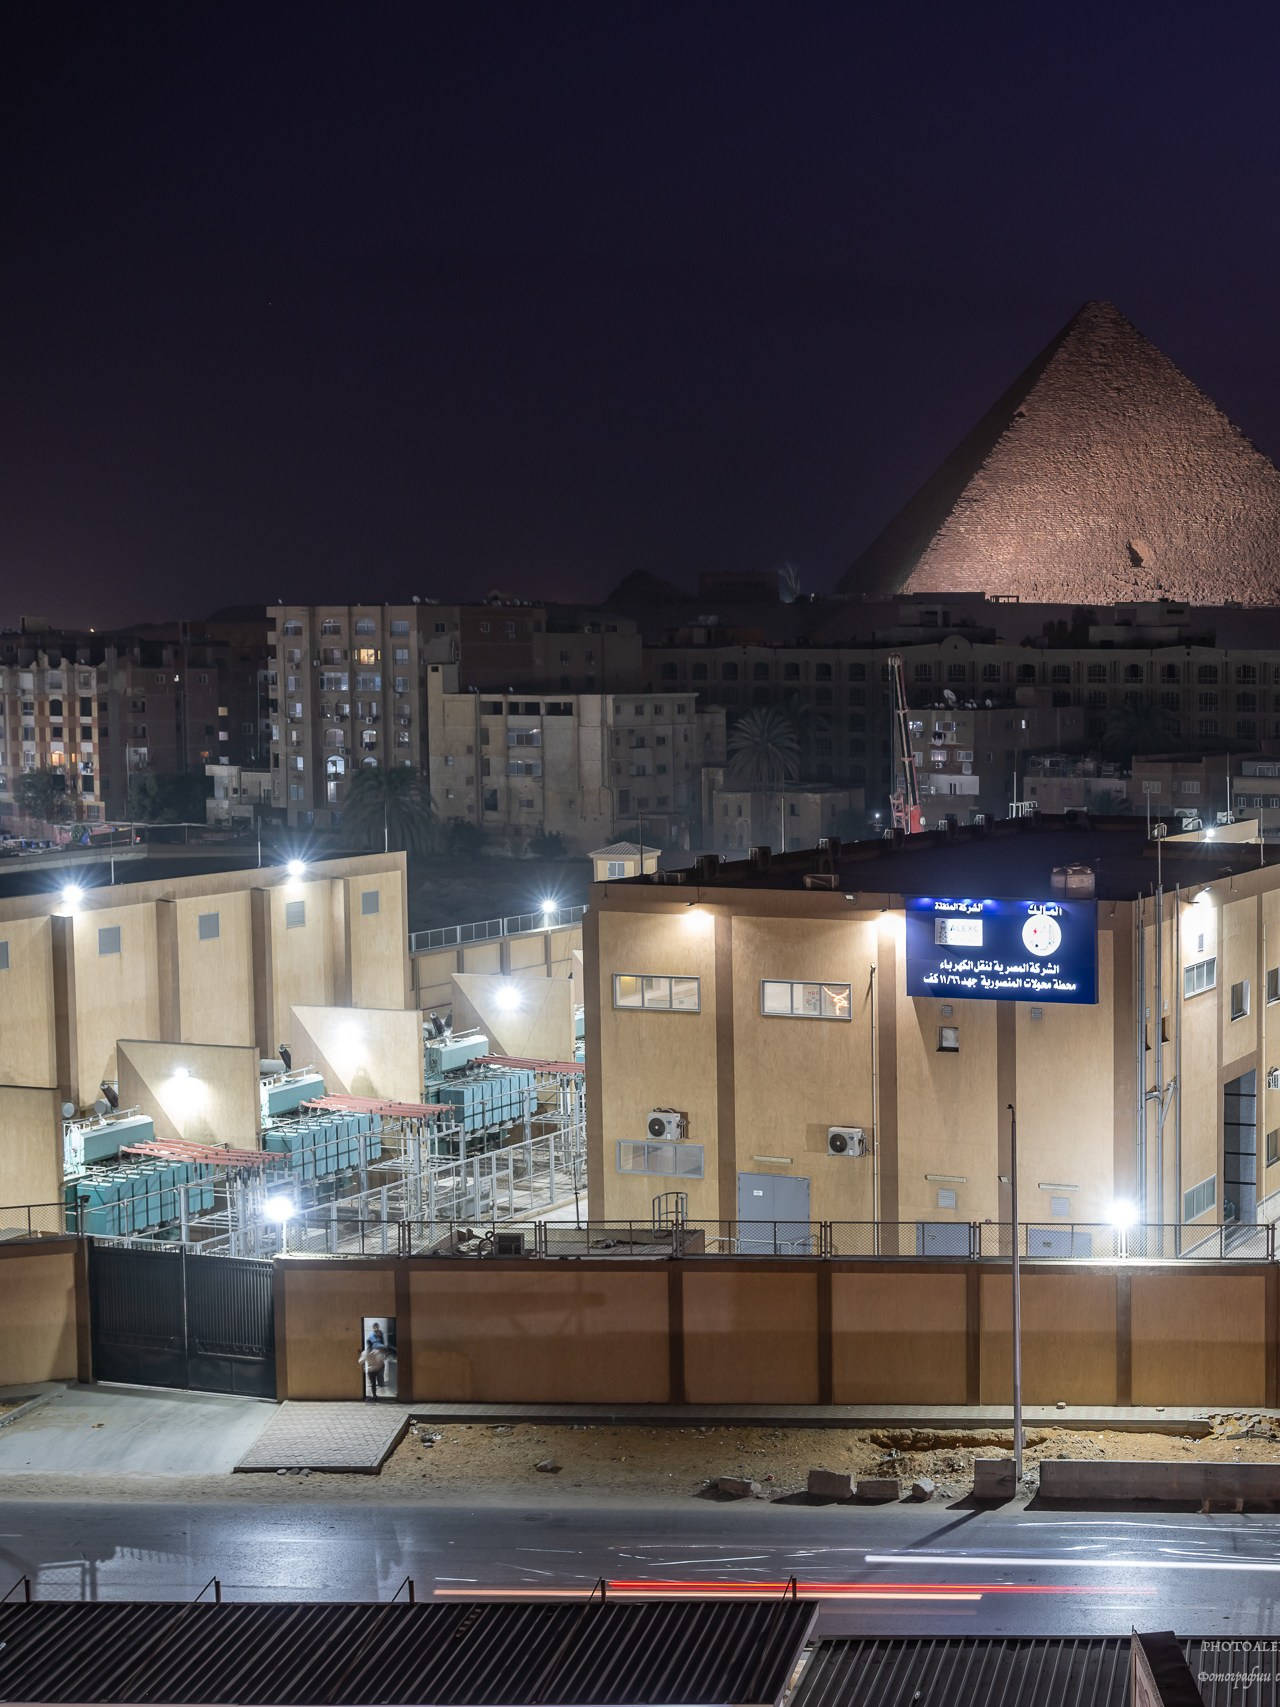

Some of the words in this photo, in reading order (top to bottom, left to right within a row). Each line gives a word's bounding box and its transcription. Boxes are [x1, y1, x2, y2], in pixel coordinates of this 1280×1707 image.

[940, 959, 974, 972] الكهرباء
[974, 960, 993, 972] لنقل
[994, 961, 1029, 975] المصرية
[1030, 962, 1060, 976] الشركة
[1053, 979, 1077, 990] محطة
